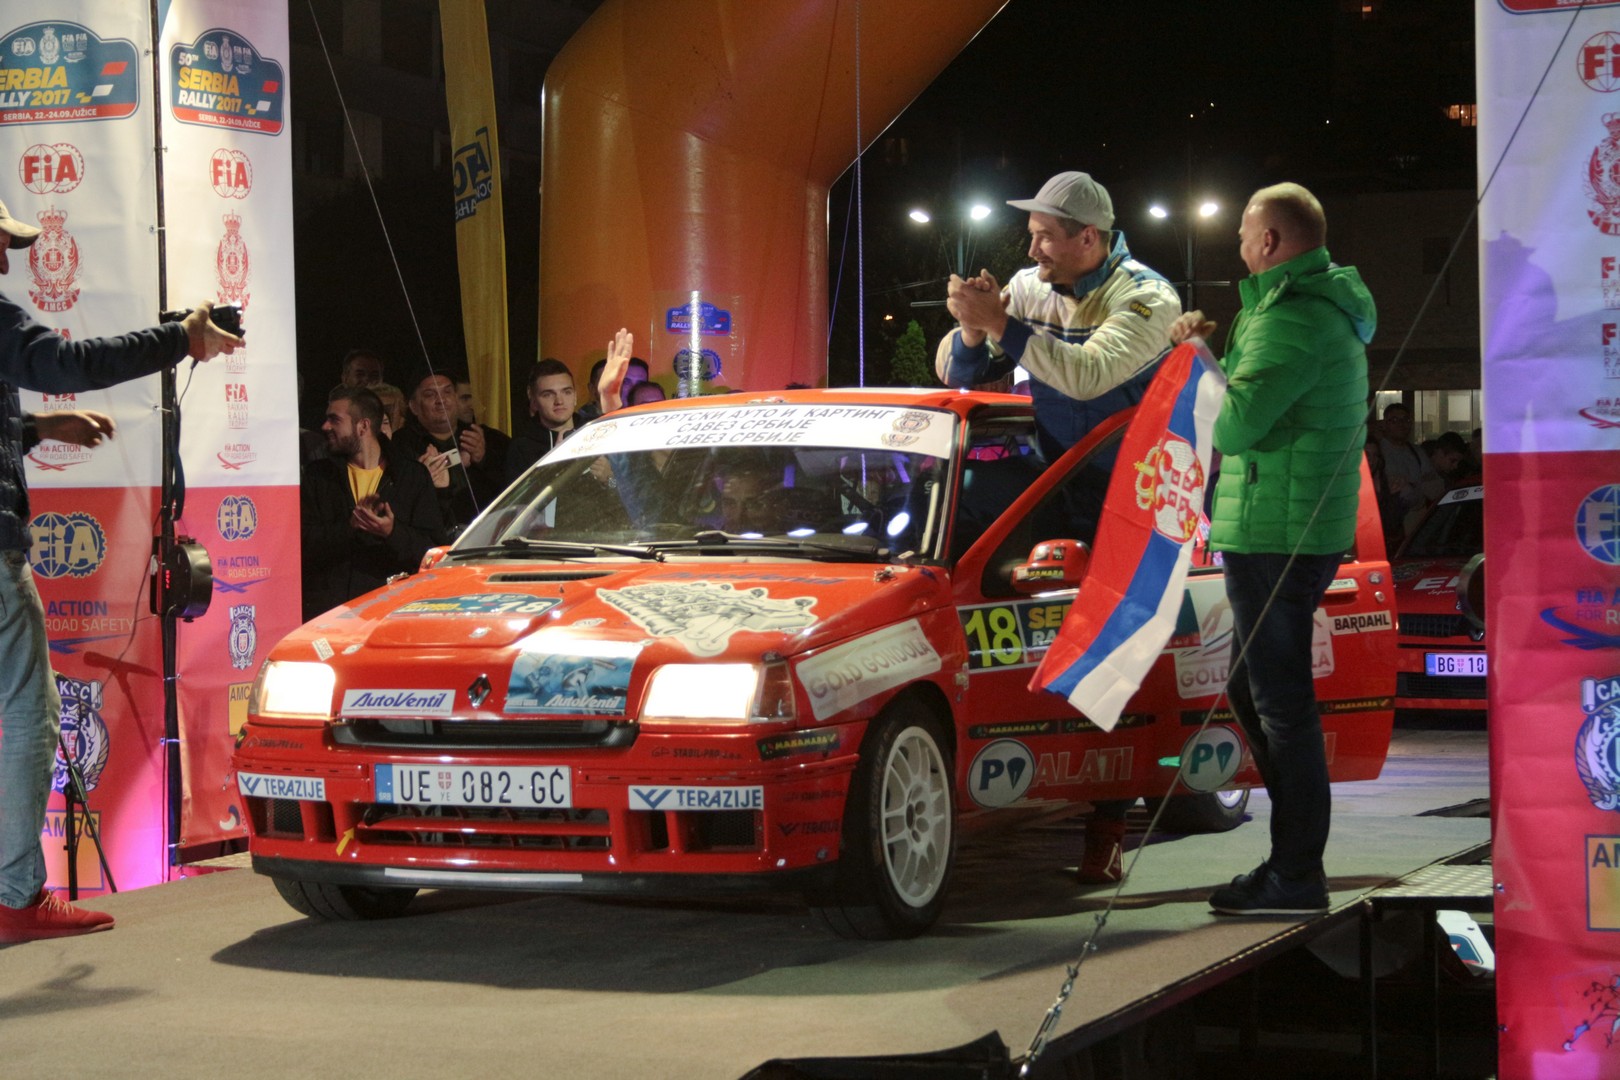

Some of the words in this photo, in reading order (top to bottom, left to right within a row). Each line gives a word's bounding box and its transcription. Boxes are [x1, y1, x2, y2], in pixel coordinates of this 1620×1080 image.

[178, 67, 240, 96] SERBIA
[31, 89, 70, 106] 2017
[178, 90, 217, 110] RALLY
[216, 95, 242, 113] 2017
[3, 112, 33, 121] SERBIA,
[629, 409, 726, 427] СПОРТСКИ
[727, 408, 776, 420] АУТО
[780, 408, 798, 418] И
[804, 408, 895, 420] КАРТИНГ
[677, 420, 738, 433] САВЕЗ
[740, 419, 816, 430] СРБИЈЕ
[665, 432, 727, 446] САВЕЗ
[729, 431, 806, 443] СРБИЈЕ
[51, 444, 81, 453] ACTION
[232, 443, 250, 452] ACTION
[68, 452, 93, 460] SAFETY
[229, 556, 260, 568] ACTION
[228, 568, 248, 578] ROAD
[248, 567, 272, 578] SAFETY
[47, 601, 108, 617] ACTION
[498, 600, 552, 614] 18
[45, 618, 79, 632] ROAD
[81, 617, 135, 632] SAFETY
[1333, 613, 1390, 631] BARDAHL
[965, 607, 1023, 667] 18
[810, 662, 863, 699] GOLD
[861, 636, 934, 673] GONDOLA
[1438, 657, 1455, 673] BG
[1180, 665, 1229, 688] GOLD
[350, 692, 447, 708] AutoVentil
[544, 694, 622, 709] AutoVentil
[1032, 746, 1134, 788] ALATI
[264, 778, 323, 799] TERAZIJE
[400, 769, 431, 802] UE
[677, 789, 762, 808] TERAZIJE
